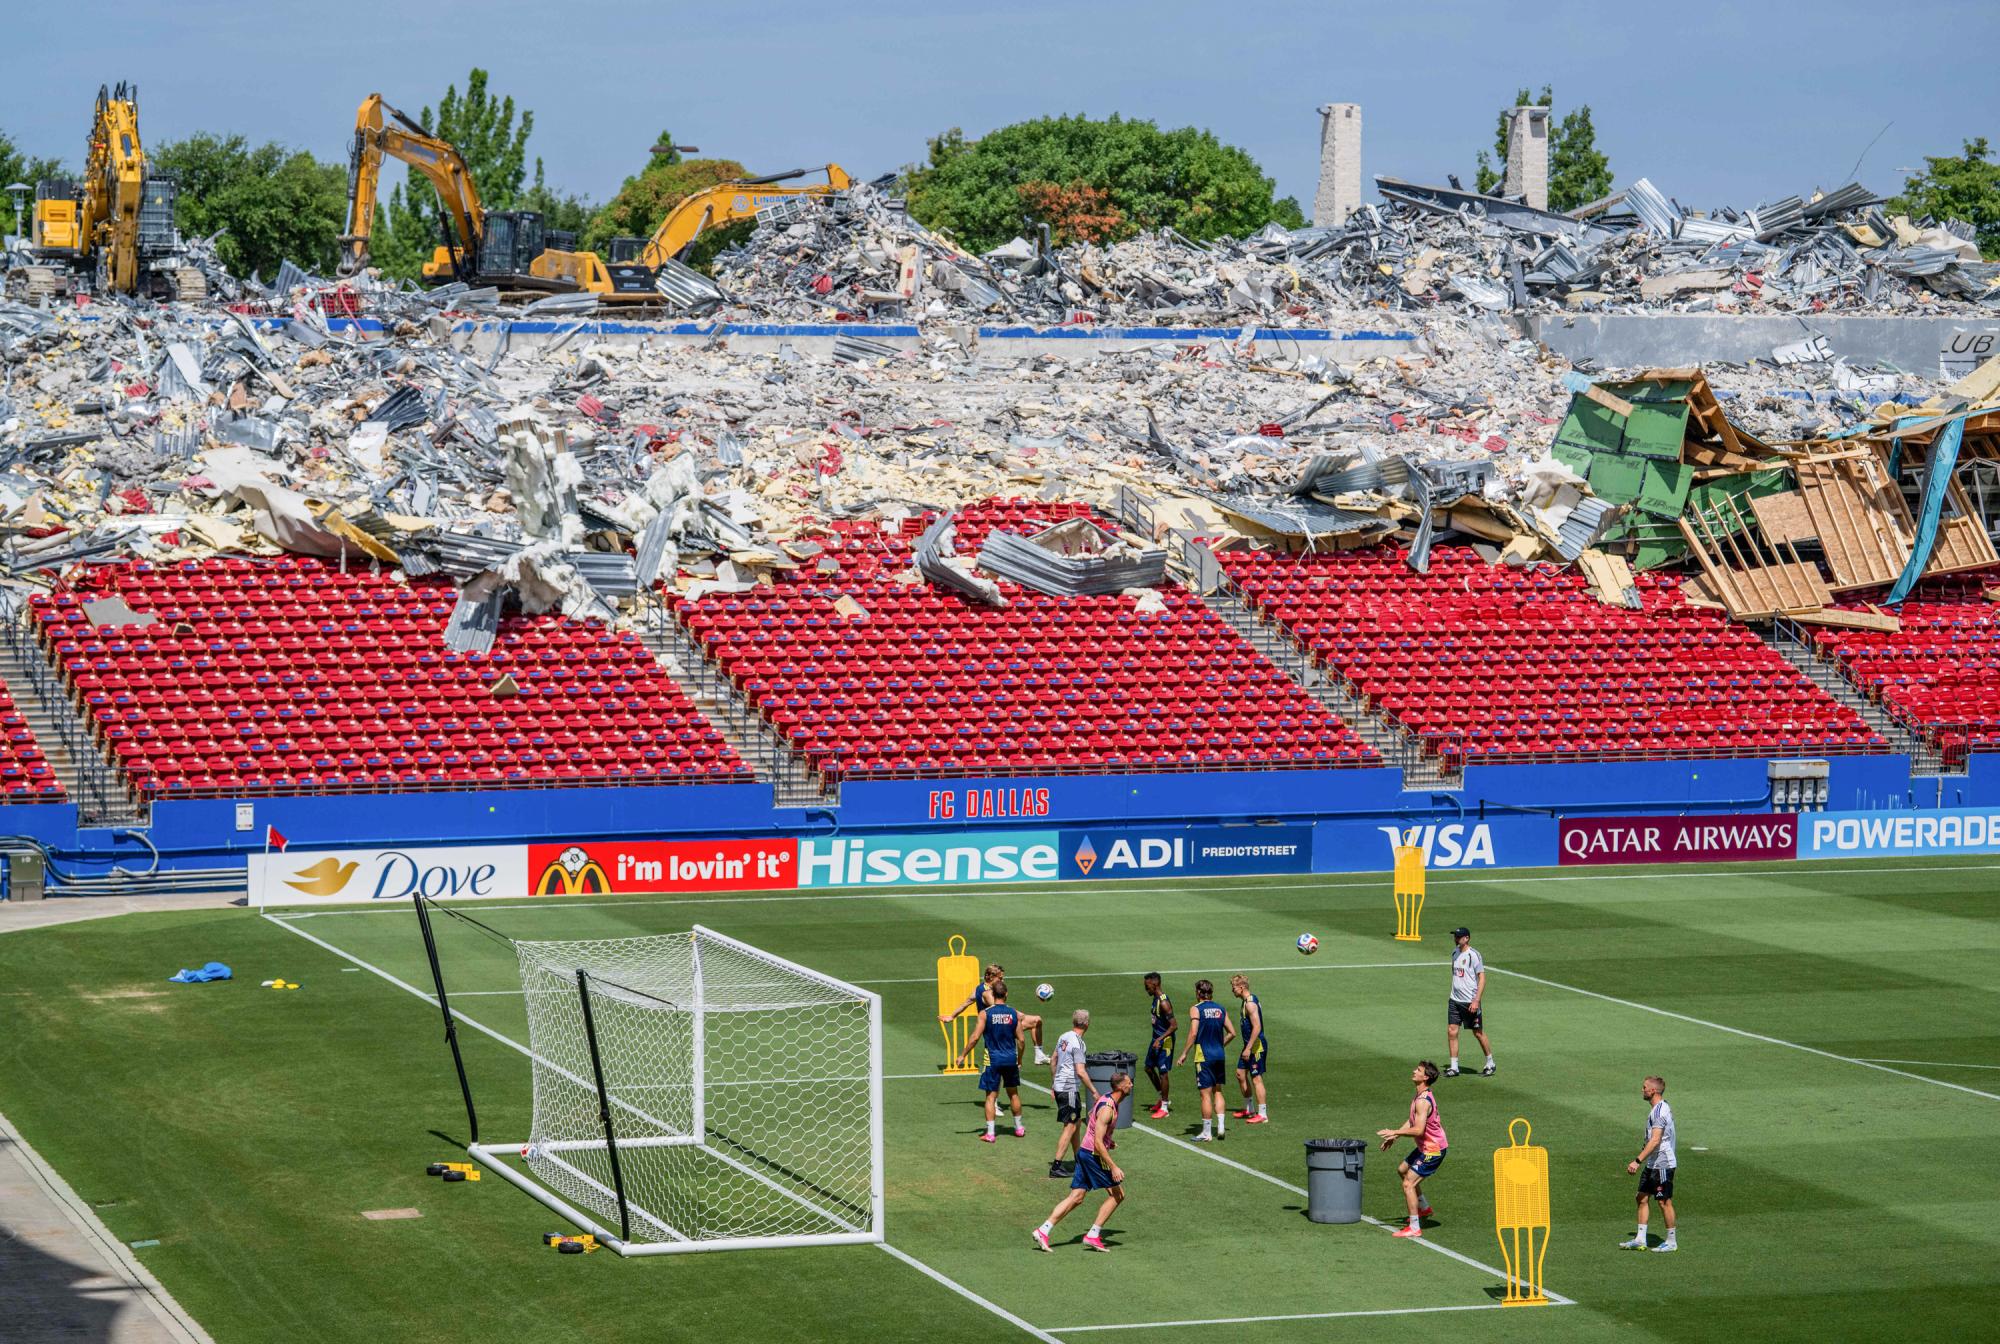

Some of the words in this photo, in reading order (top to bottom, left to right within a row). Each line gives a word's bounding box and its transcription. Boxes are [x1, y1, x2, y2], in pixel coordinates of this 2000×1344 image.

[1941, 334, 1995, 353] UB
[929, 790, 954, 819] FC
[966, 787, 1050, 817] DALLAS
[1378, 824, 1496, 867] VISA
[1564, 827, 1661, 853] QATAR
[1674, 824, 1792, 852] AIRWAYS
[1813, 815, 2000, 850] POWERADE
[617, 853, 662, 881] i'm
[670, 852, 751, 880] lovin'
[798, 839, 1059, 885] Hisense
[1103, 838, 1183, 869] ADI
[1202, 845, 1297, 857] PREDICTSTREET
[372, 851, 496, 899] Dove
